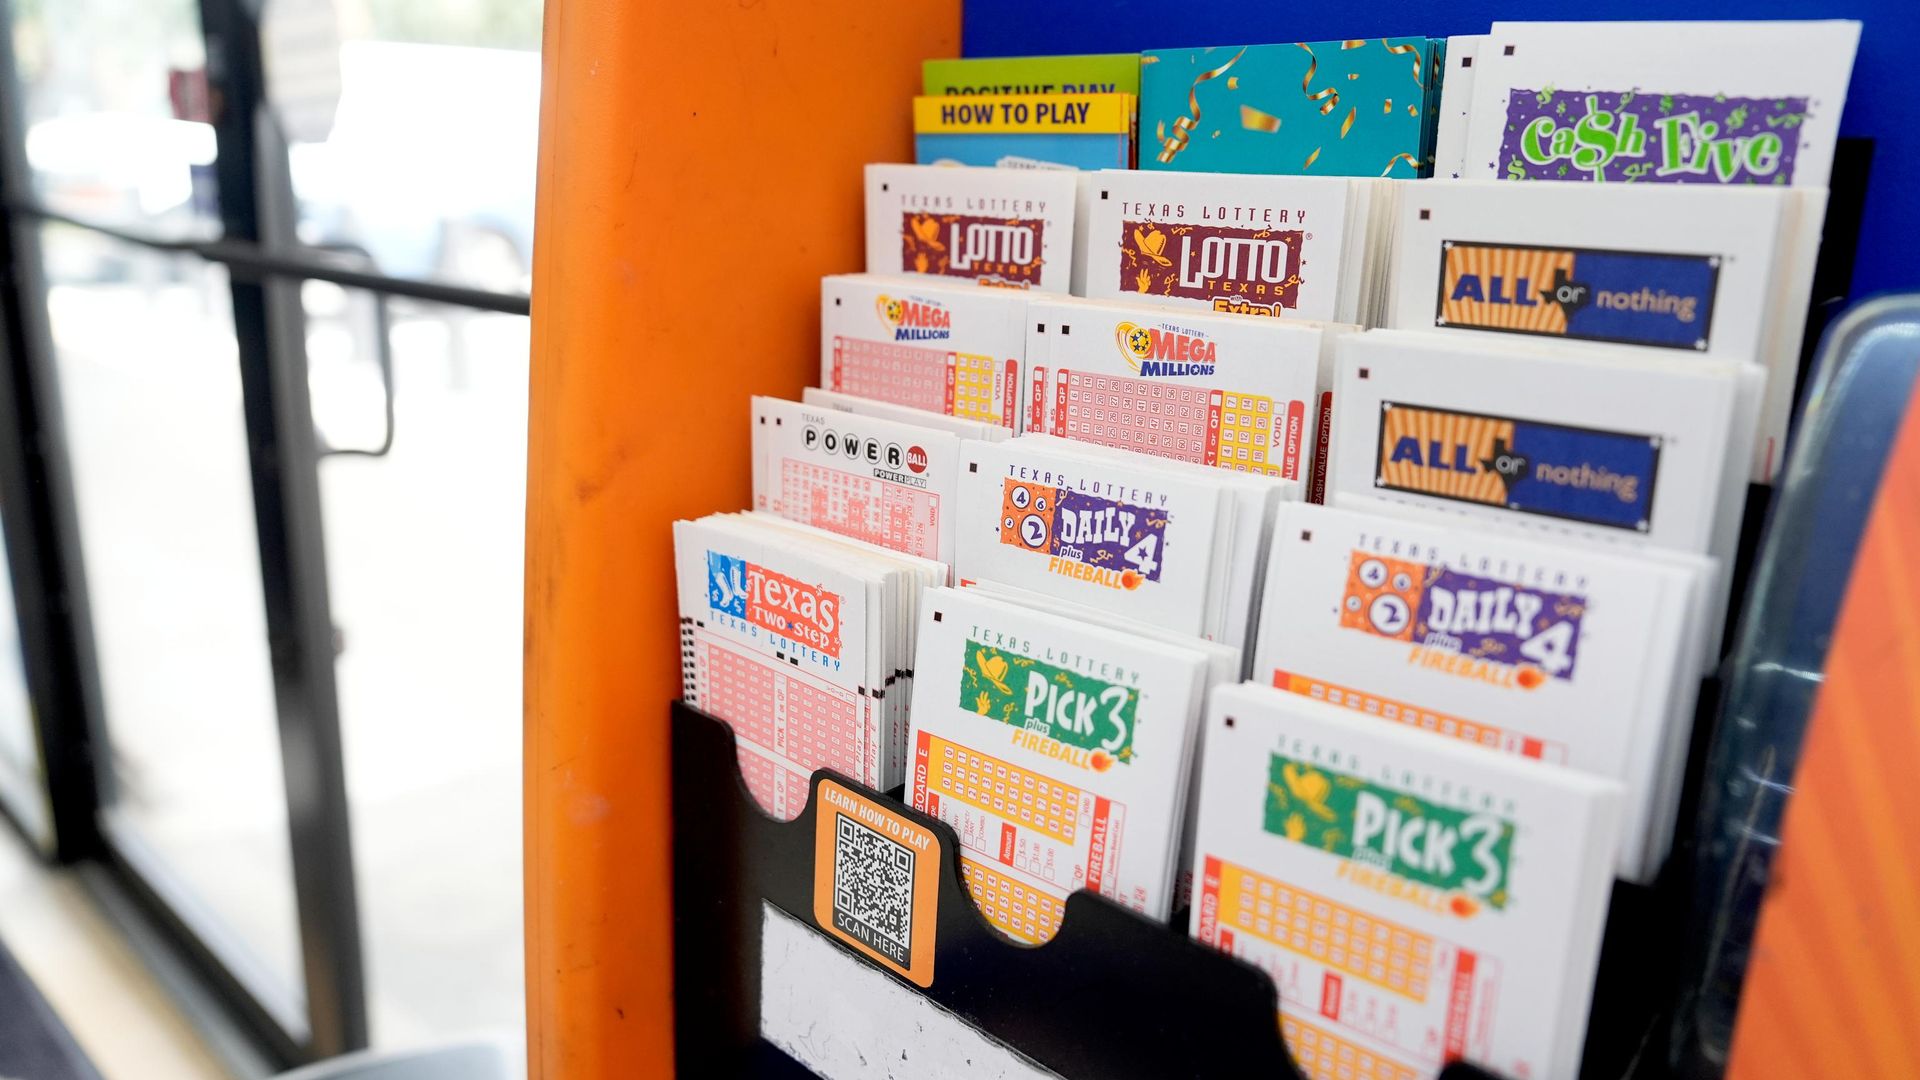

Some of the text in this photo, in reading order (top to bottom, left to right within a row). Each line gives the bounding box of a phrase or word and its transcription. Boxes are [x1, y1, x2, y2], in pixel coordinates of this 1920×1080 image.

[941, 102, 1091, 125] HOW TO PLAY
[1653, 110, 1783, 183] Five
[901, 194, 1047, 211] TEXAS LOTTERY
[1122, 202, 1306, 224] TEXAS LOTTERY
[950, 222, 1034, 270] LOTTO
[1180, 235, 1289, 289] LOTTO
[973, 262, 1032, 276] TEXAS
[1208, 280, 1285, 296] TEXAS
[1450, 273, 1697, 323] ALL or nothing
[899, 300, 951, 329] MEGA
[1162, 323, 1205, 339] TEXAS LOTTERY
[895, 328, 950, 341] MILLIONS
[1143, 328, 1216, 363] MEGA
[1139, 361, 1216, 377] MILLIONS
[994, 373, 1002, 400] VOID
[1005, 372, 1015, 407] OPTION
[1035, 384, 1042, 402] QP
[1058, 387, 1066, 405] QP
[801, 413, 825, 425] TEXAS
[1210, 409, 1220, 429] QP
[1272, 416, 1283, 448] VOID
[1320, 407, 1332, 445] OPTION
[806, 428, 928, 467] POWER BALL
[1210, 432, 1218, 446] or
[1286, 416, 1300, 480] ALUE OPTION
[1317, 449, 1328, 477] VALUE
[1389, 435, 1639, 504] ALL or nothing
[1009, 464, 1168, 507] TEXAS LOTTERY
[1016, 490, 1026, 504] 4
[1028, 520, 1044, 541] 2
[1060, 506, 1159, 576] DAILY 4
[1060, 546, 1082, 560] plus
[1048, 557, 1122, 590] FIREBALL
[746, 569, 835, 634] Texas
[1382, 602, 1401, 624] 2
[710, 609, 841, 672] TEXAS LOTTERY
[752, 605, 831, 650] TWO Step
[1428, 585, 1575, 674] DAILY 4
[971, 625, 1140, 686] TEXAS LOTTERY
[1023, 670, 1130, 752] PICK 3
[1025, 719, 1048, 735] plus
[1011, 728, 1090, 770] FIREBALL
[914, 747, 929, 812] BOARD E
[824, 786, 930, 852] LEARN HOW TO PLAY
[1003, 831, 1014, 860] Amount
[1089, 816, 1107, 884] FIREBALL
[1352, 790, 1503, 897] PICK 3
[1073, 864, 1084, 879] QP
[1200, 892, 1218, 944] OARD
[838, 912, 905, 963] SCAN HERE
